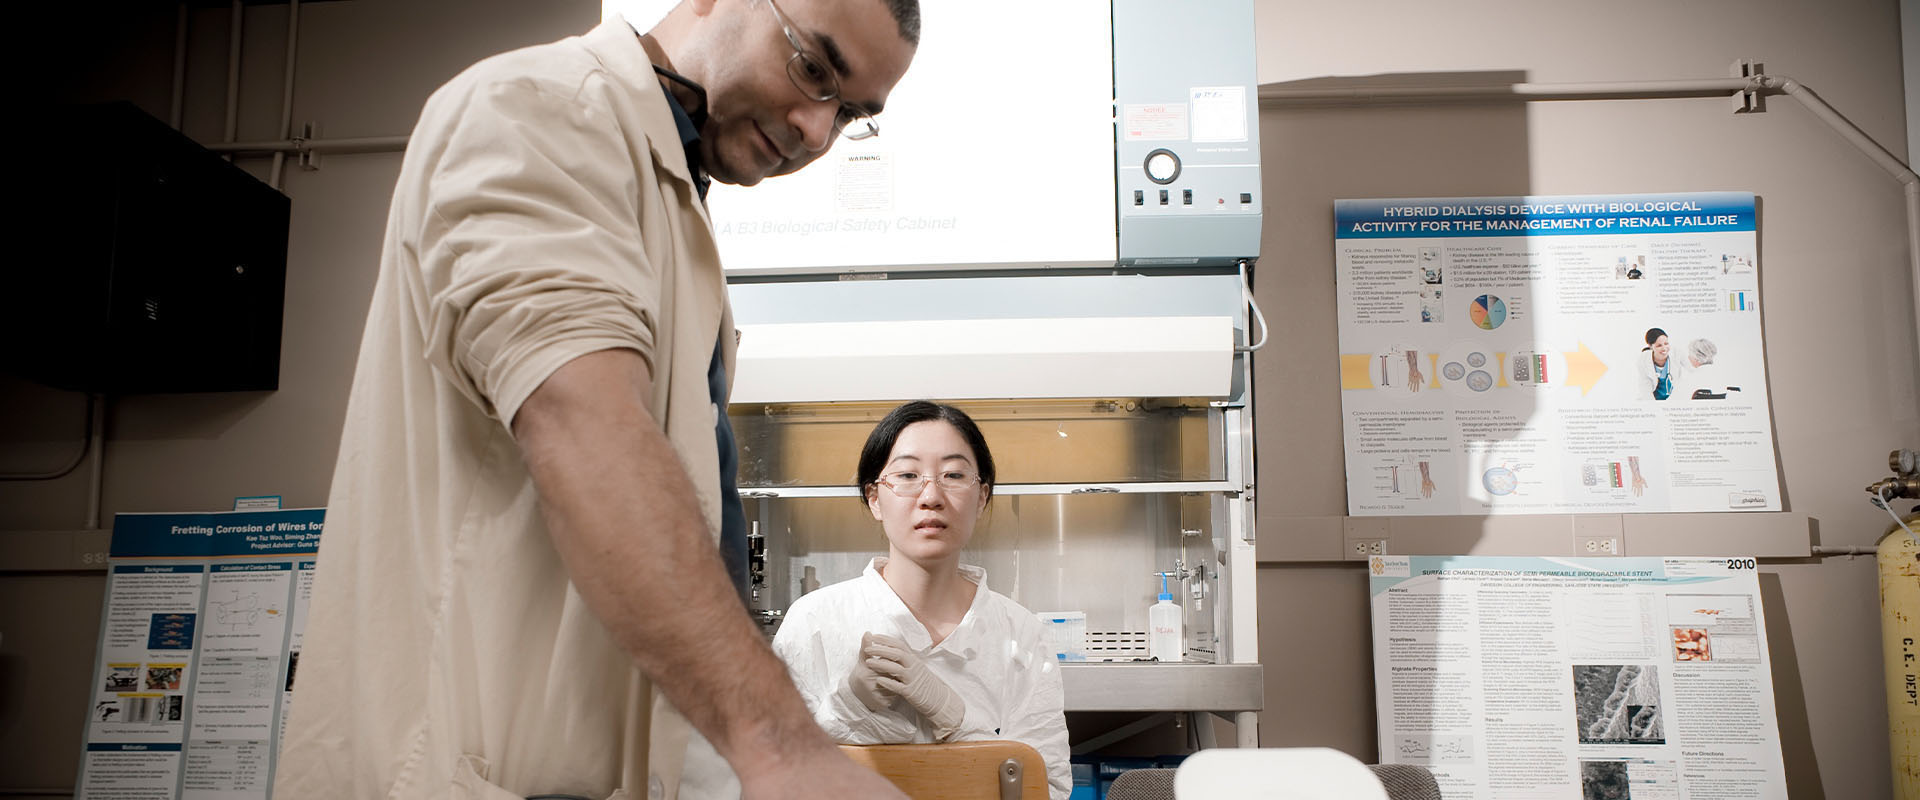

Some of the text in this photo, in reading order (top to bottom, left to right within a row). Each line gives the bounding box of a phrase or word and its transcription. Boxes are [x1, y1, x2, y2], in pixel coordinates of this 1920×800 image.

[1384, 201, 1702, 217] HYBRID DIALYSIS DEVICE WITH BIOLOGICAL
[760, 219, 839, 237] Biological
[840, 217, 891, 234] Safety
[895, 216, 957, 231] Cabinet
[1352, 215, 1738, 232] ACTIVITY FOR THE MANAGEMENT OF RENAL FAILURE
[171, 521, 323, 536] Fretting Corrosion of Wires for
[1727, 559, 1755, 570] 2010
[1903, 637, 1918, 706] C.E. DEPT
